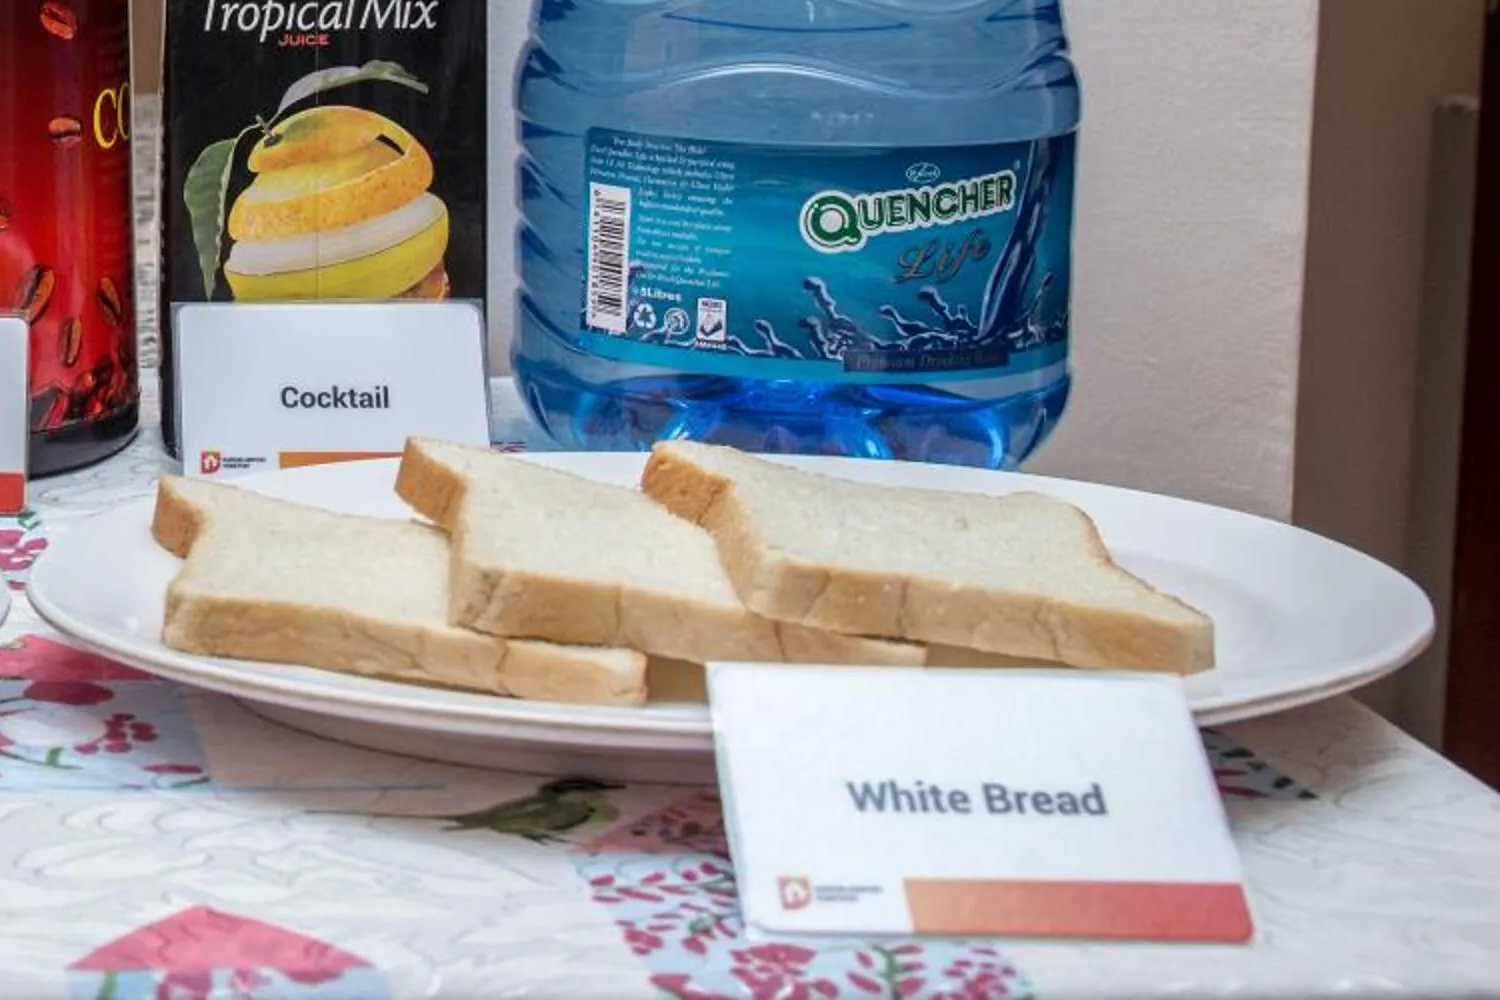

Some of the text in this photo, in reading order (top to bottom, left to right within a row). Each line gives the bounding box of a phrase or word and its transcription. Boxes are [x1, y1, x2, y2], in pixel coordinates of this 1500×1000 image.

[278, 33, 330, 47] JUICE
[280, 385, 390, 409] Cocktail
[847, 780, 1108, 817] White Bread
